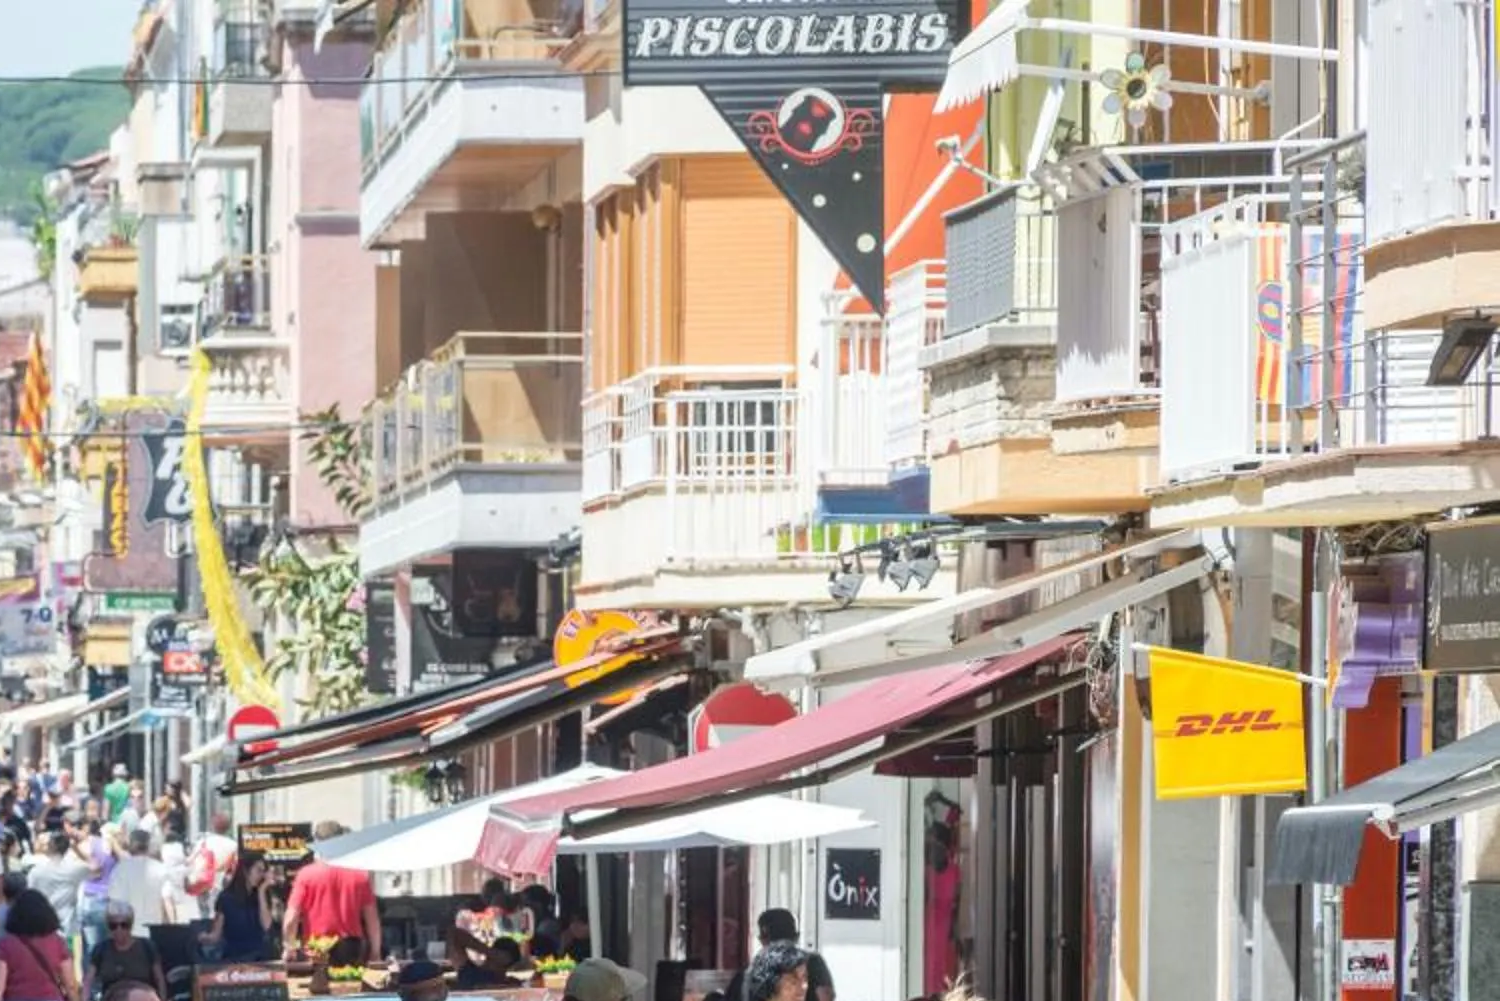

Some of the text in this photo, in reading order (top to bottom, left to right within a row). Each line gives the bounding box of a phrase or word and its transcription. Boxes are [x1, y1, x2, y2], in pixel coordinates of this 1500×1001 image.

[636, 12, 949, 57] PISCOLABIS
[1175, 709, 1281, 736] DHL
[828, 863, 877, 907] Ònix
